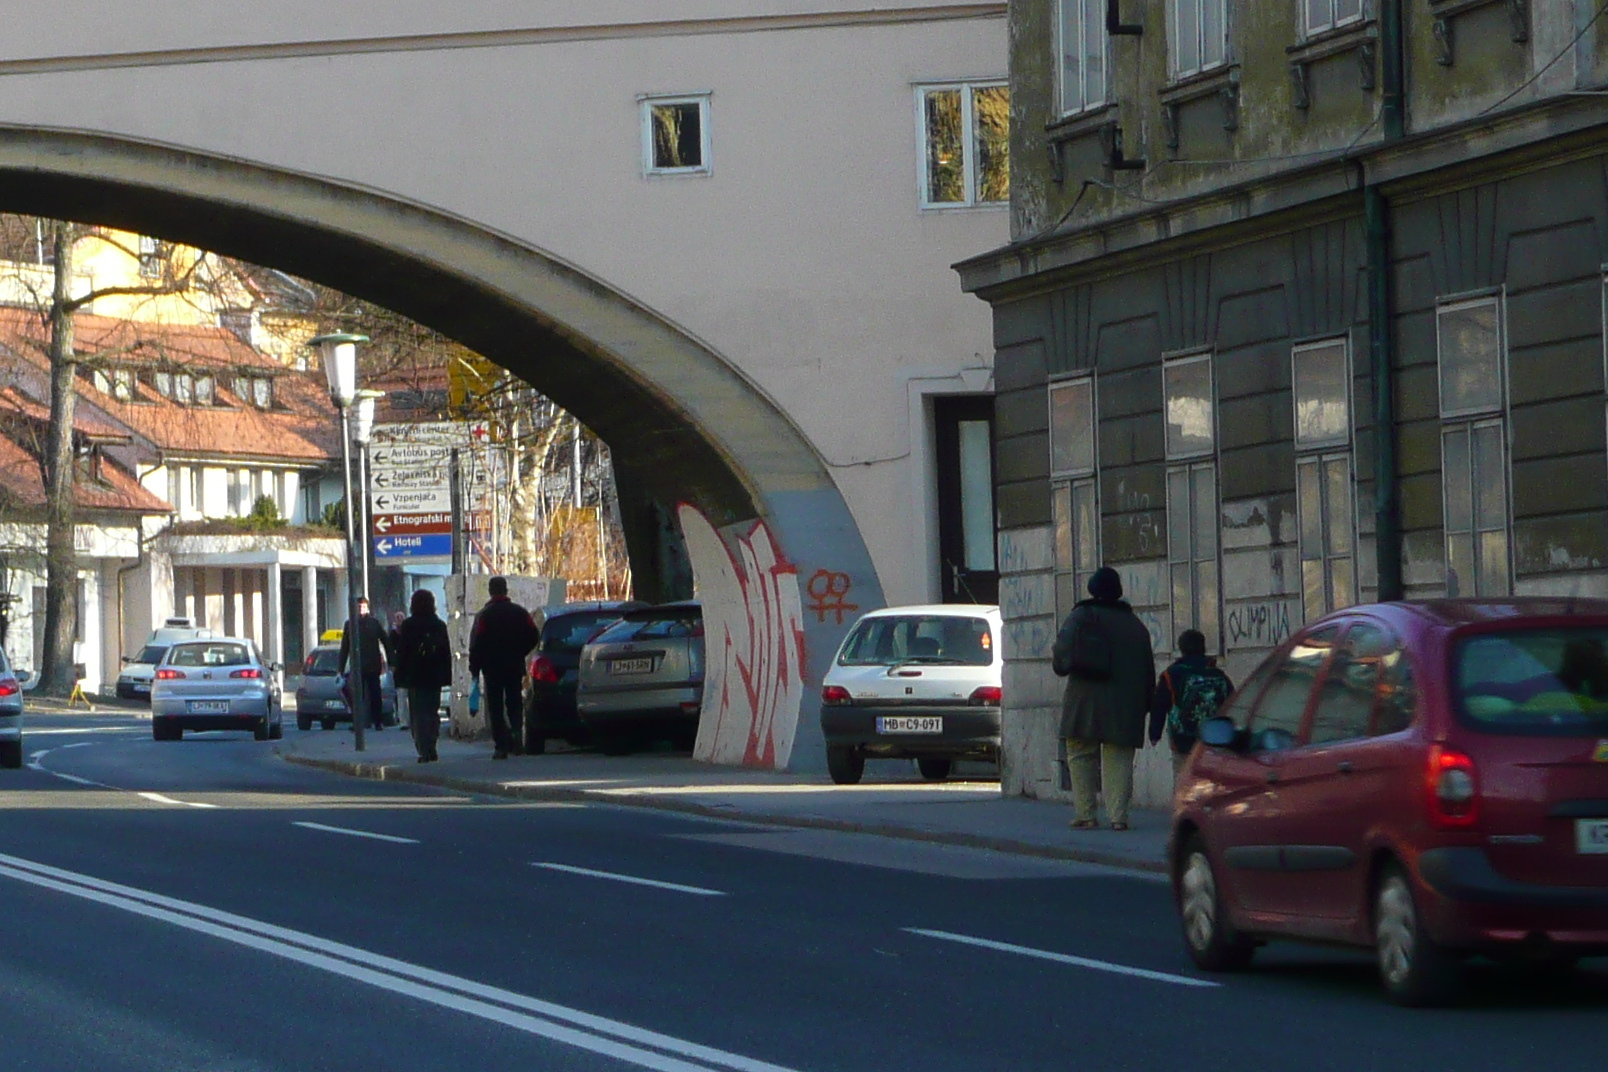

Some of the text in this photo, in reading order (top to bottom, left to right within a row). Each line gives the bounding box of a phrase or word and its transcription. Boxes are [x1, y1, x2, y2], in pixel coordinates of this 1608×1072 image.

[431, 448, 454, 459] post
[392, 492, 436, 503] Vzpenjača
[394, 514, 442, 526] Etnografski
[884, 718, 941, 730] MB C9-09T
